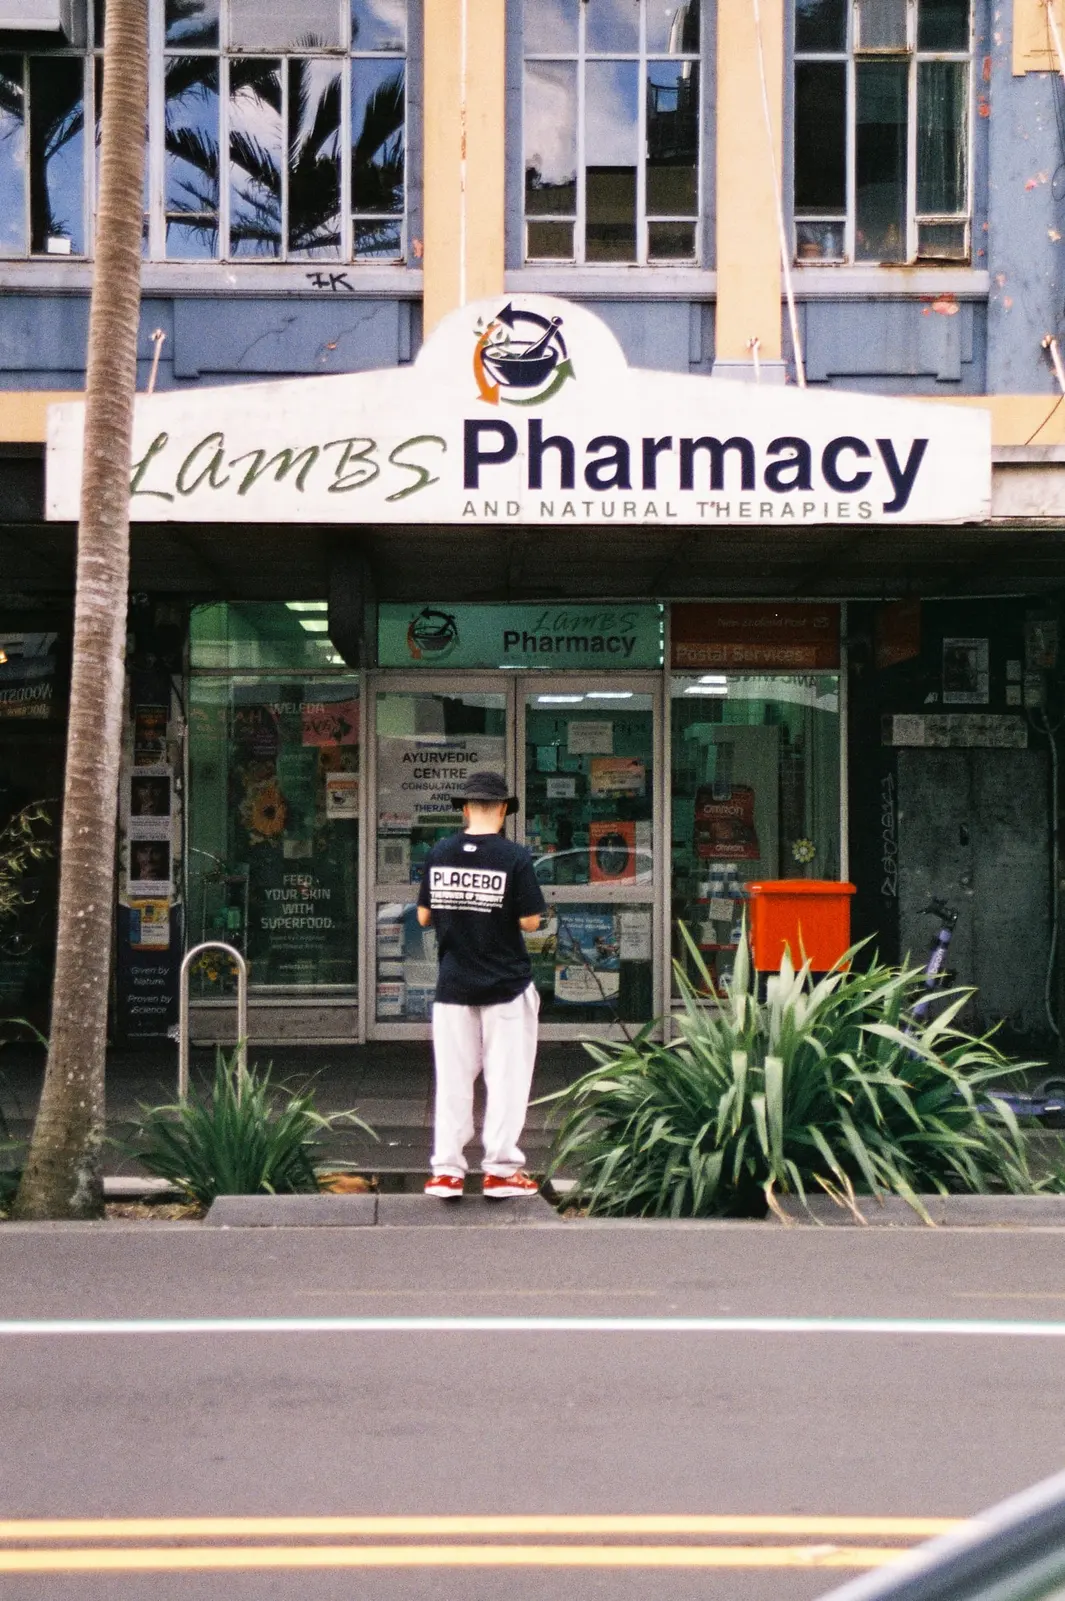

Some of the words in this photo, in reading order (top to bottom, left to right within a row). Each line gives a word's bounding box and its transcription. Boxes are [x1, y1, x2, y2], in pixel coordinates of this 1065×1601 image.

[463, 418, 929, 513] Pharmacy
[463, 501, 521, 517] AND
[540, 501, 678, 517] NATURAL
[696, 501, 873, 518] THERAPIES
[503, 631, 637, 658] Pharmacy
[676, 646, 728, 662] Postal
[732, 646, 804, 662] Services
[402, 752, 478, 763] AYURVEDIC
[413, 768, 468, 779] CENTRE
[282, 874, 313, 886] FEED
[433, 871, 502, 890] PLACEBO
[264, 888, 298, 901] YOUR
[301, 888, 331, 901] SKIN
[281, 902, 315, 915] WITH
[157, 965, 170, 977] by
[127, 993, 159, 1005] Proven
[160, 993, 173, 1005] by
